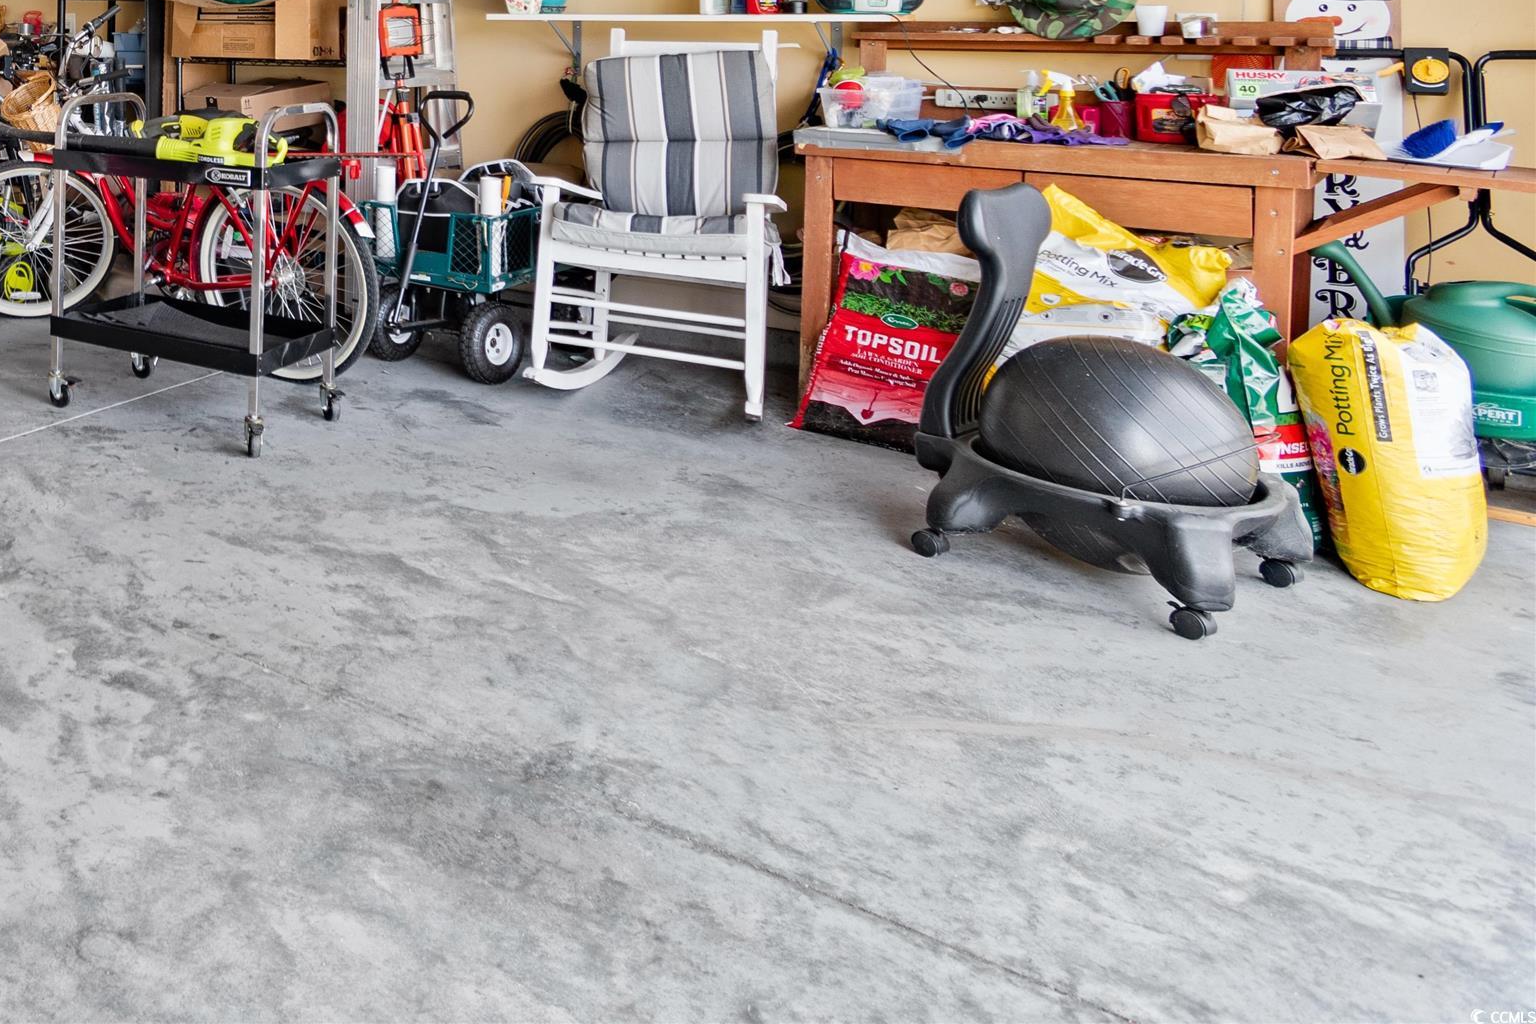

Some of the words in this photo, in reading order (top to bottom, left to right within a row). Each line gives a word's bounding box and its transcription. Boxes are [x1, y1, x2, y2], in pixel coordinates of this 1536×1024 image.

[1234, 71, 1285, 79] HUSKY
[1239, 85, 1257, 94] 40
[221, 171, 247, 182] KOBALT
[1038, 249, 1090, 277] Potting
[1089, 271, 1118, 288] Mix
[844, 325, 942, 364] TOPSOIL
[1324, 332, 1345, 361] Mix
[868, 356, 923, 375] CONDITIONER
[1365, 353, 1376, 364] As
[1368, 364, 1382, 390] Twice
[1329, 365, 1356, 437] Potting
[1373, 390, 1384, 414] Plants
[1378, 414, 1389, 440] Grows
